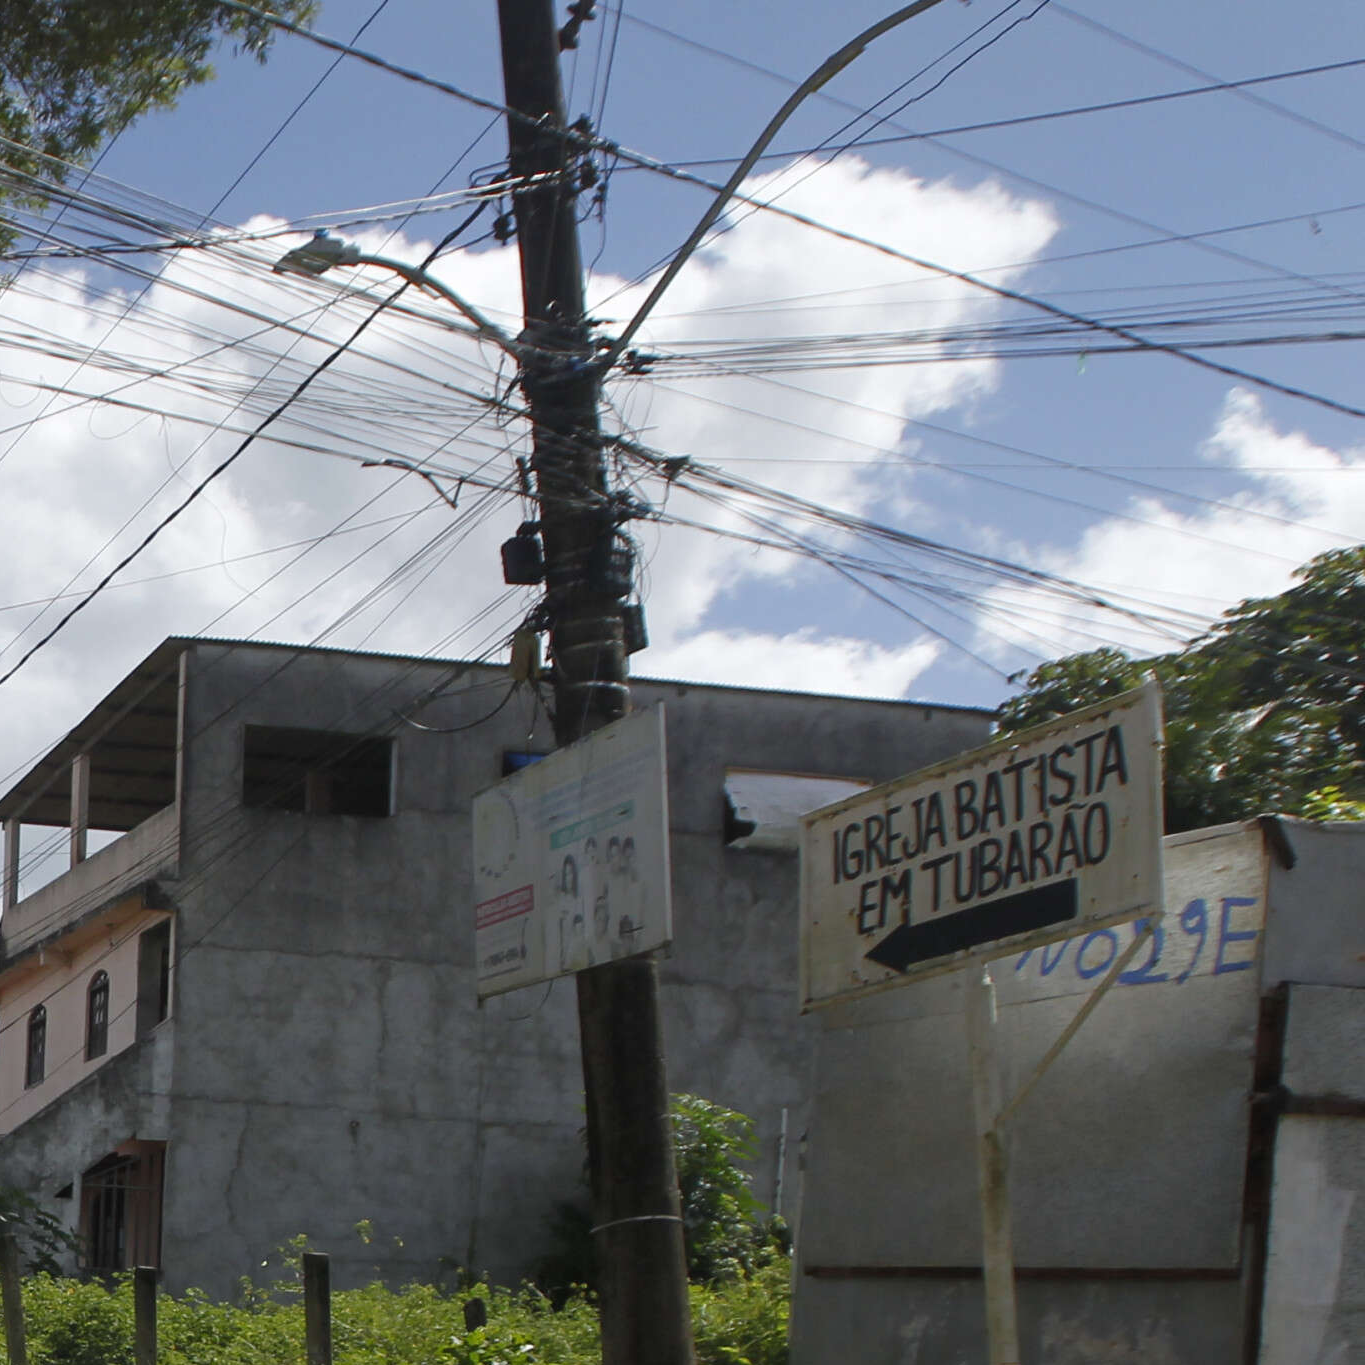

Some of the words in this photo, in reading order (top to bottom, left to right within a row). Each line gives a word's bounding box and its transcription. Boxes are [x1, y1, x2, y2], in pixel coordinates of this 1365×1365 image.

[833, 791, 947, 885] IGREJA
[954, 725, 1127, 841] BATISTA
[858, 869, 912, 935] EM
[921, 801, 1111, 912] TUBARÃO
